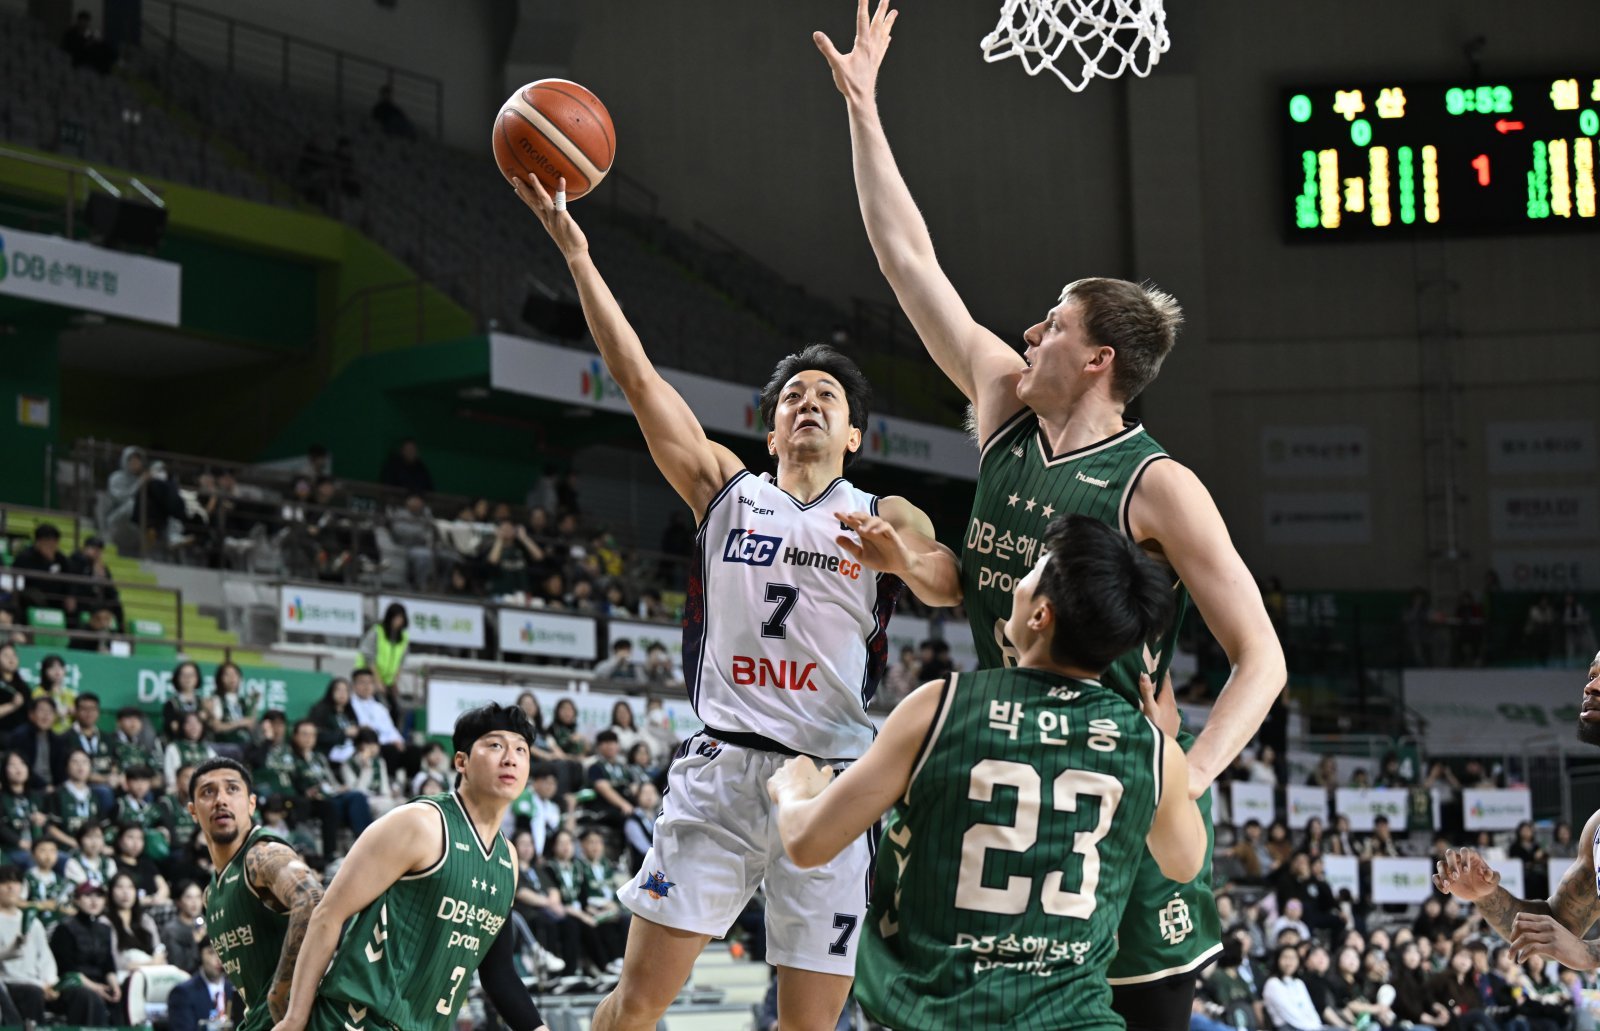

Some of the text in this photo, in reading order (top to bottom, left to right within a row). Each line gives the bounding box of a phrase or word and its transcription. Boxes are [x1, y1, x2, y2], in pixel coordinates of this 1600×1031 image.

[1290, 95, 1312, 122] 0
[1580, 109, 1599, 136] 0
[1351, 119, 1372, 146] 0
[519, 138, 563, 179] molten
[1472, 154, 1490, 186] 1
[12, 251, 119, 297] DB손해보험
[1075, 471, 1110, 489] hummel
[726, 531, 775, 563] KCC
[967, 517, 1050, 568] DB손해
[978, 567, 1018, 592] pro
[761, 582, 800, 639] 7
[732, 655, 818, 692] BNK
[955, 758, 1124, 920] 23
[210, 923, 254, 956] 손해보험
[828, 912, 858, 957] 7
[436, 965, 466, 1016] 3
